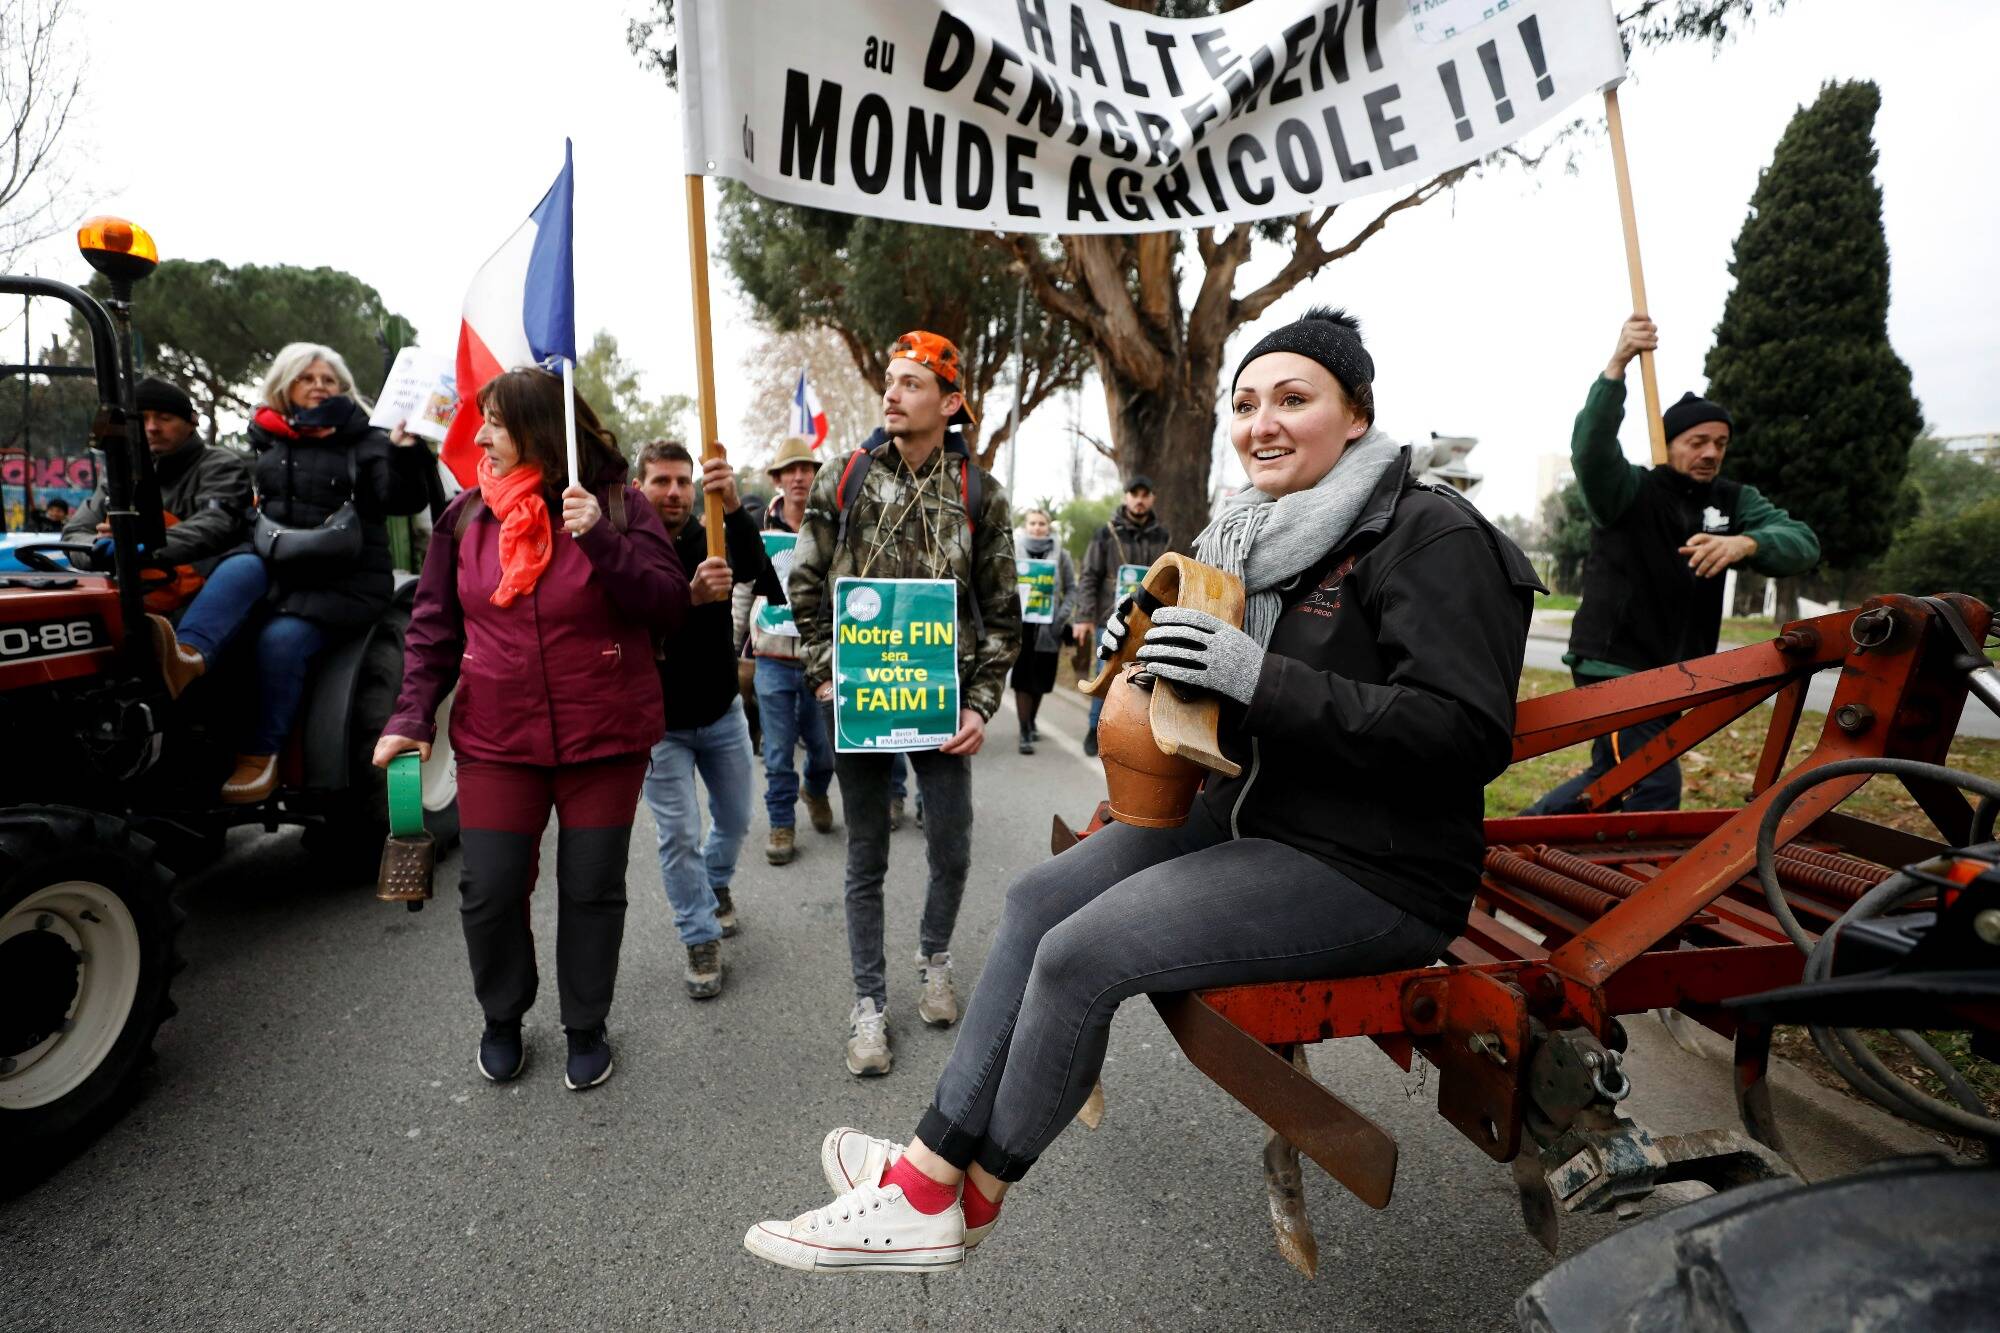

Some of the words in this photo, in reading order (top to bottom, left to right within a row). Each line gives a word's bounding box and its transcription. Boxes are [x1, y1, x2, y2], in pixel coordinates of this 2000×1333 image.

[864, 32, 895, 75] au
[1017, 0, 1243, 98] HALTE
[742, 113, 755, 164] du
[779, 68, 1042, 218] MONDE
[1066, 84, 1419, 222] AGRICOLE
[839, 624, 903, 645] Notre
[909, 621, 953, 645] FIN
[881, 652, 908, 662] sera
[865, 666, 928, 682] votre
[856, 687, 927, 711] FAIM
[938, 686, 945, 710] !
